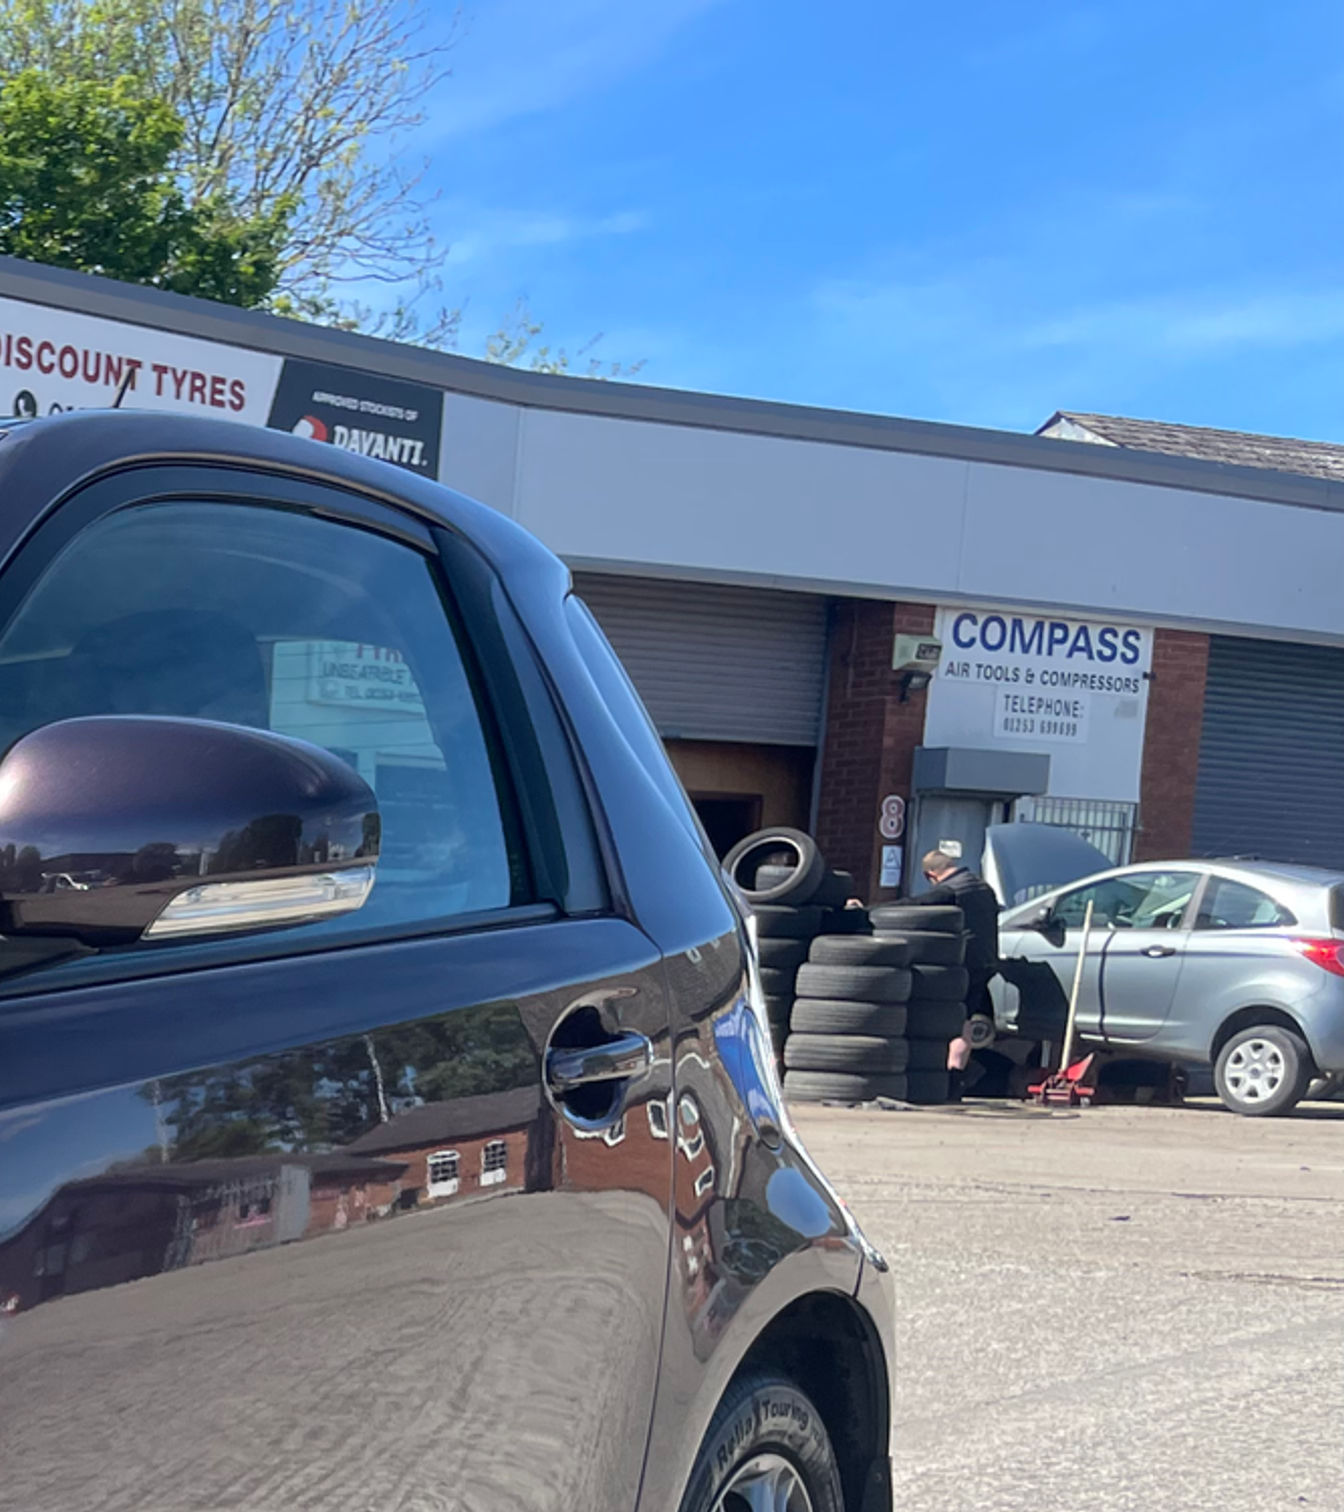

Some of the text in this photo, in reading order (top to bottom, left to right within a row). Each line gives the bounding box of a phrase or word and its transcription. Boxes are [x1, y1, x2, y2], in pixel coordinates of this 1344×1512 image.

[152, 363, 246, 412] TYRES
[952, 612, 1142, 665] COMPASS
[945, 661, 1140, 694] AIR TOOLS & COMPRESSORS
[879, 794, 906, 839] 8
